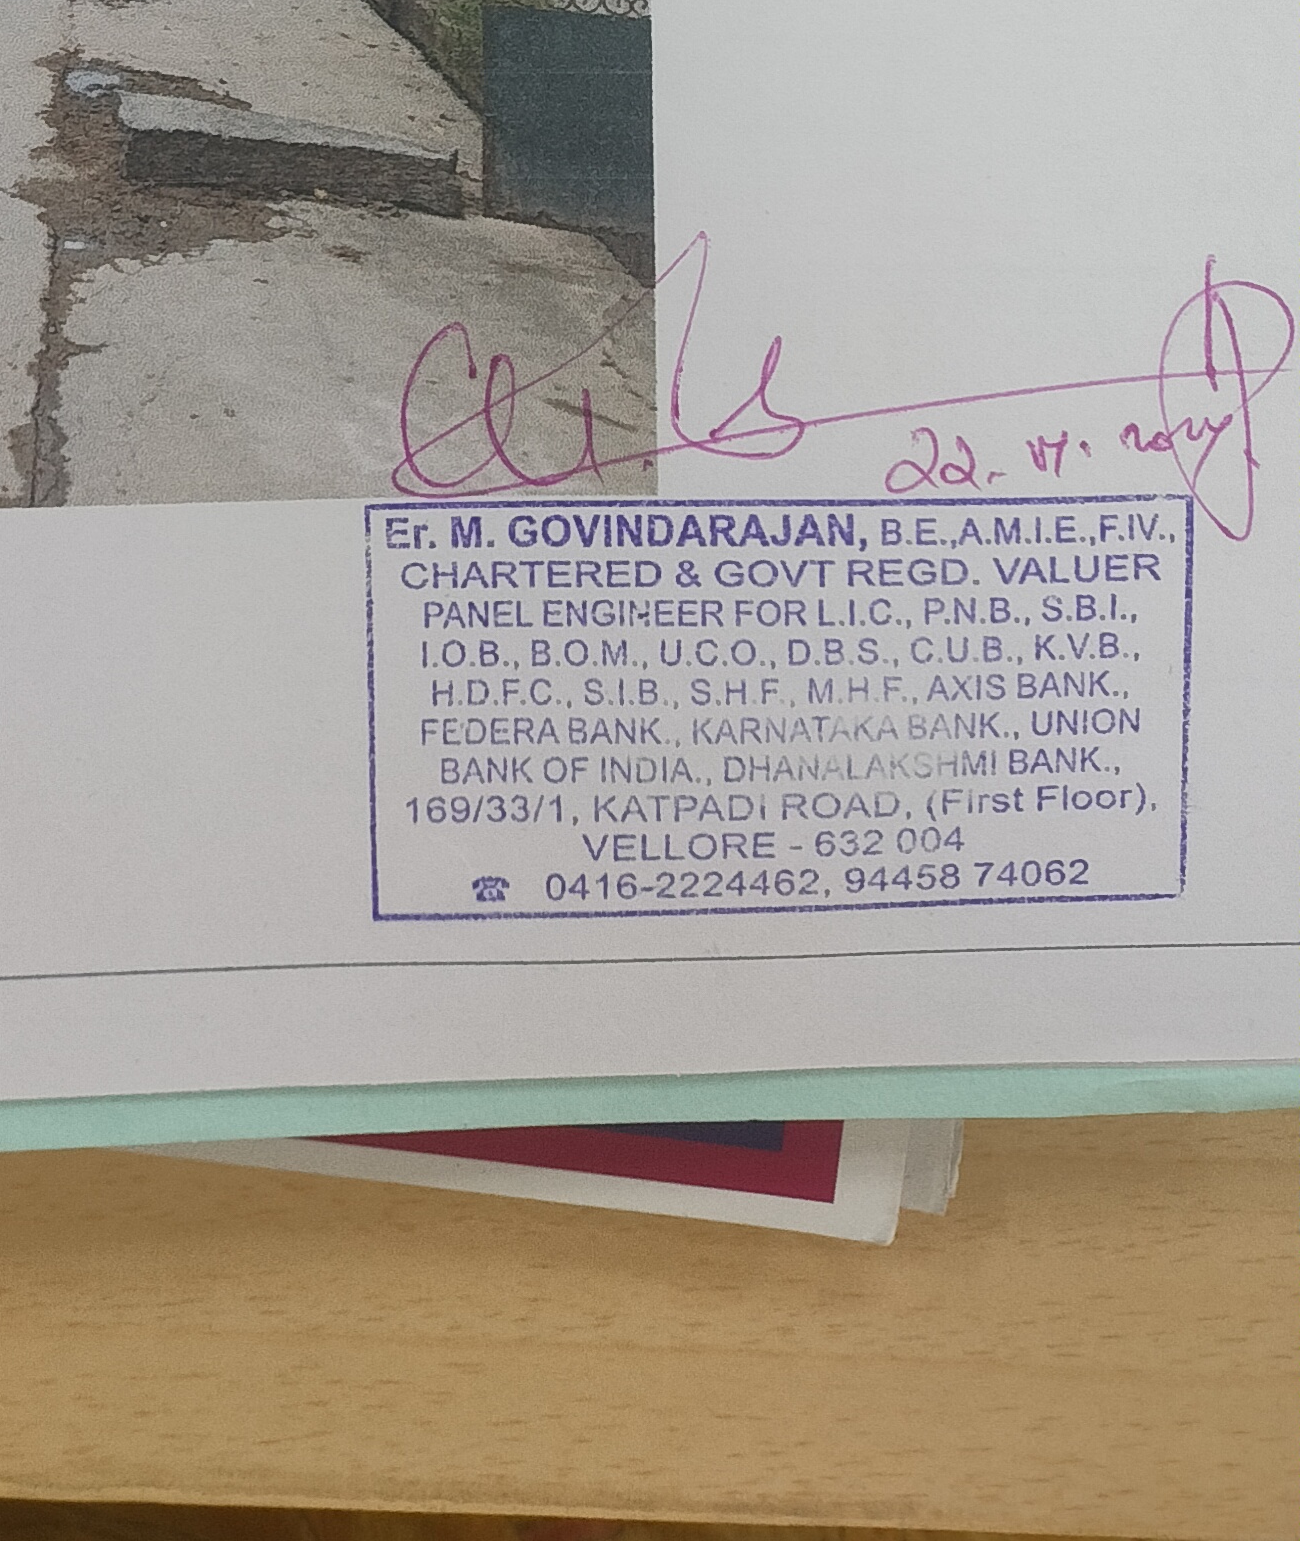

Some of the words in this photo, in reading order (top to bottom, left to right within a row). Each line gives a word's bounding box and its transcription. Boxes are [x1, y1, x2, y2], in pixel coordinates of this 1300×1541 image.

[386, 518, 436, 549] Er.
[452, 516, 494, 548] M.
[509, 514, 867, 551] GOVINDARAJAN,
[401, 561, 661, 589] CHARTERED
[676, 561, 701, 587] &
[715, 560, 834, 587] GOVT
[848, 559, 979, 587] REGD.
[993, 554, 1161, 584] VALUER
[424, 601, 533, 628] PANEL
[544, 600, 723, 627] ENGINEER
[735, 600, 806, 626] FOR
[819, 599, 911, 628] L.I.C.,
[925, 597, 1030, 626] P.N.B.,
[1042, 594, 1137, 623] S.B.I.,
[422, 640, 519, 669] I.O.B.,
[532, 640, 647, 669] B.O.M.,
[661, 639, 775, 669] U.C.O.,
[788, 638, 898, 667] D.B.S.,
[911, 636, 1022, 664] C.U.B.,
[1035, 632, 1139, 661] K.V.B.,
[432, 679, 571, 708] H.D.F.C.,
[585, 679, 678, 709] S.I.B.,
[927, 674, 1005, 701] AXIS
[1018, 670, 1128, 699] BANK.,
[422, 718, 559, 745] FEDERA
[569, 718, 679, 747] BANK.,
[693, 716, 897, 744] KARNATAKA
[909, 713, 1019, 740] BANK.,
[1032, 708, 1140, 736] UNION
[442, 758, 532, 784] BANK
[544, 757, 588, 783] OF
[602, 757, 711, 785] INDIA.,
[724, 751, 996, 782] DHANALAKSHMI
[1009, 747, 1120, 775] BANK.,
[406, 795, 578, 825] 169/33/1,
[595, 795, 765, 822] KATPADI
[782, 793, 911, 820] ROAD,
[927, 788, 1023, 821] (First
[1037, 783, 1156, 815] Floor),
[582, 832, 775, 861] VELLORE
[815, 830, 883, 857] 632
[897, 827, 964, 853] 004
[546, 869, 830, 901] 0416-2224462,
[845, 864, 960, 893] 94458
[974, 859, 1089, 887] 74062
